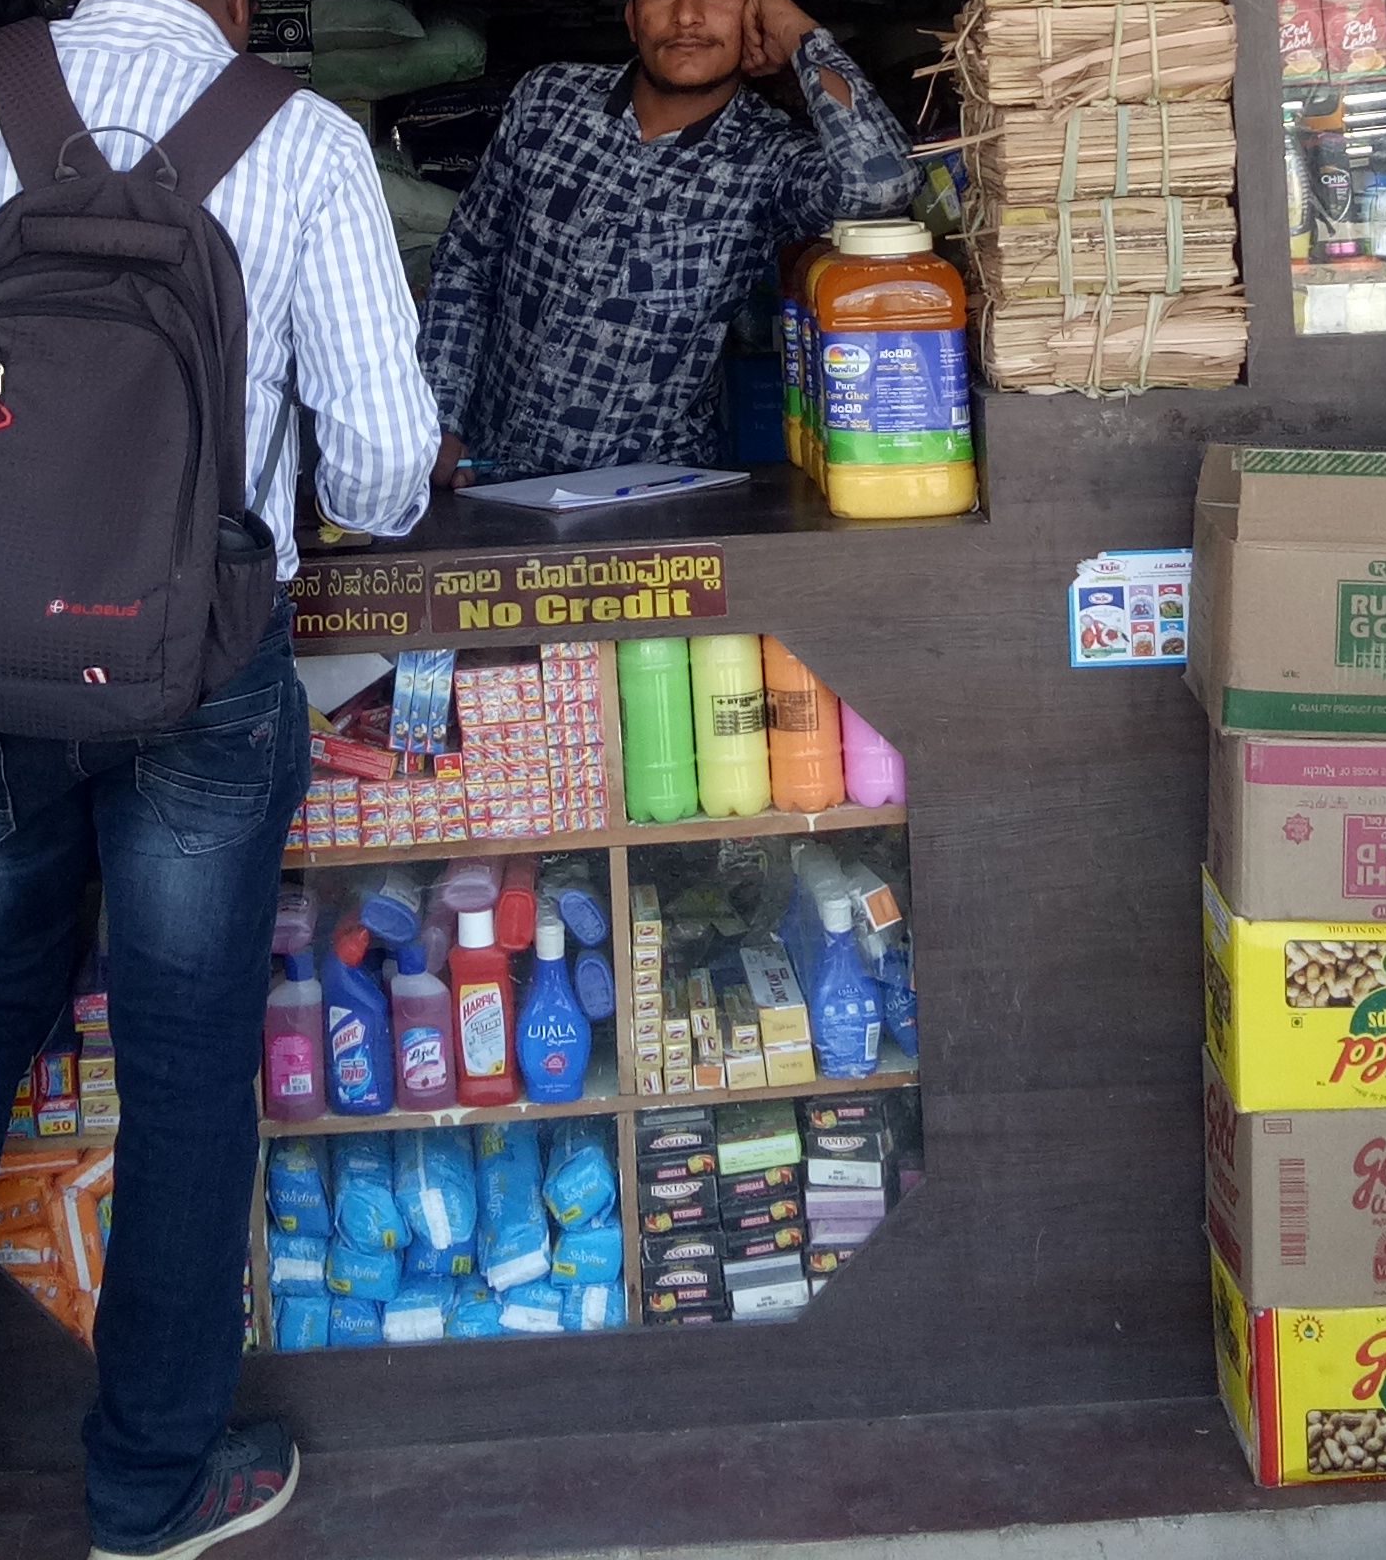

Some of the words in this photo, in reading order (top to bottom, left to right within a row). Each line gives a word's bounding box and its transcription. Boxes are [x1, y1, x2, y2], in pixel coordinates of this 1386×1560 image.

[1280, 23, 1310, 38] Red
[1343, 20, 1374, 37] Red
[1280, 33, 1313, 52] Label
[1343, 32, 1377, 50] Label
[1321, 174, 1347, 186] CHIK
[434, 568, 501, 596] ಸಾಲ
[458, 599, 522, 630] No
[534, 589, 692, 625] Credit
[296, 607, 409, 635] moking
[1303, 766, 1335, 778] Ruchi
[463, 992, 498, 1018] HARPIC
[527, 1023, 576, 1040] UJALA
[567, 1250, 607, 1266] Stayfree
[342, 1264, 381, 1281] Stayfree
[333, 1315, 376, 1332] Stayfree
